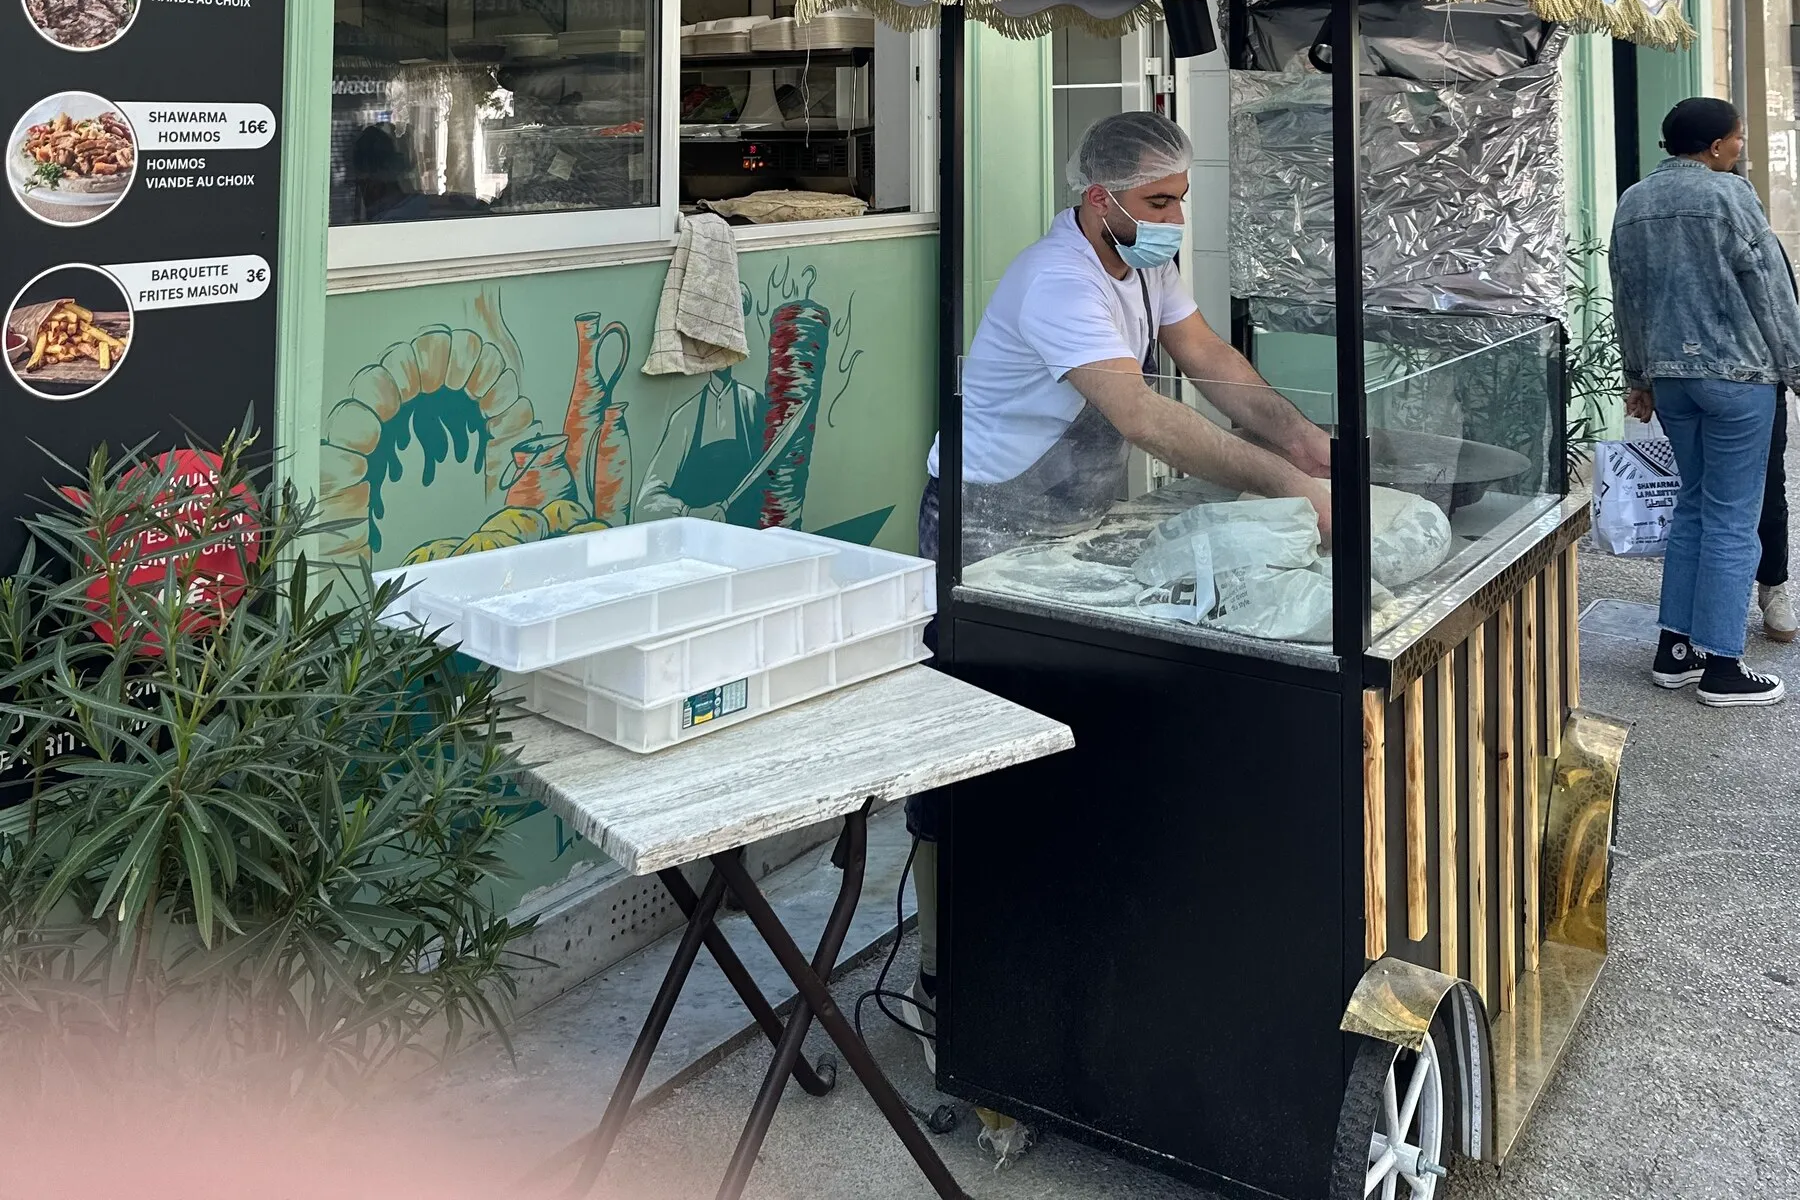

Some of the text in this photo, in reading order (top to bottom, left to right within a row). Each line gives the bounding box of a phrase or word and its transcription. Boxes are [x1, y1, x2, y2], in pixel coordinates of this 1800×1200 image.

[148, 111, 227, 124] SHAWARMA
[238, 119, 268, 135] 16€
[158, 131, 221, 143] HOMMOS
[146, 158, 206, 170] HOMMOS
[145, 174, 255, 188] VIANDE AU CHOIX
[151, 264, 229, 283] BARQUETTE
[245, 267, 267, 283] 3€
[139, 281, 239, 303] FRITES MAISON
[1637, 481, 1680, 490] SHAWARMA
